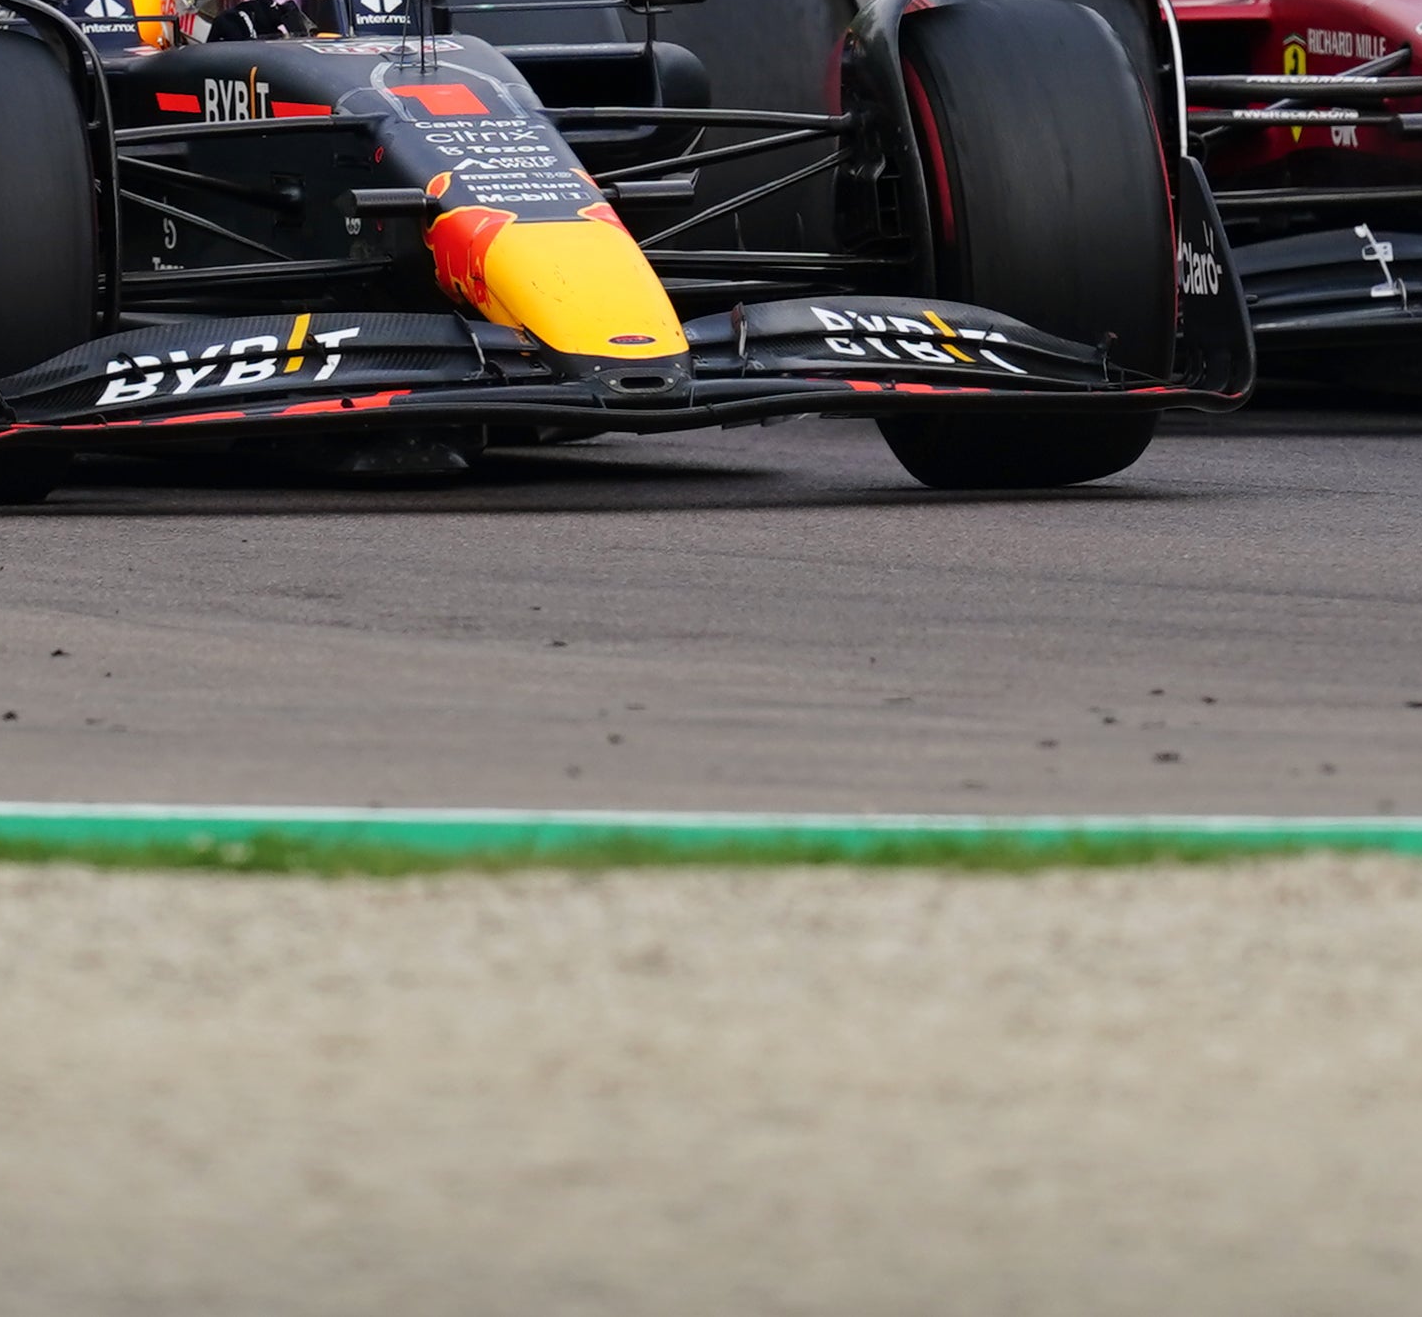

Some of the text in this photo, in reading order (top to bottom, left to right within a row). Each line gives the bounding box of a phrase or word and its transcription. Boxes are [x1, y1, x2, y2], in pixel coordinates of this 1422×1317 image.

[82, 23, 136, 34] inter.mx
[1307, 28, 1353, 58] RICHARD
[204, 66, 270, 123] BYBIT
[388, 83, 491, 116] 1
[414, 119, 528, 129] Cash App
[475, 192, 559, 203] Mobil
[95, 312, 361, 407] BYBIT
